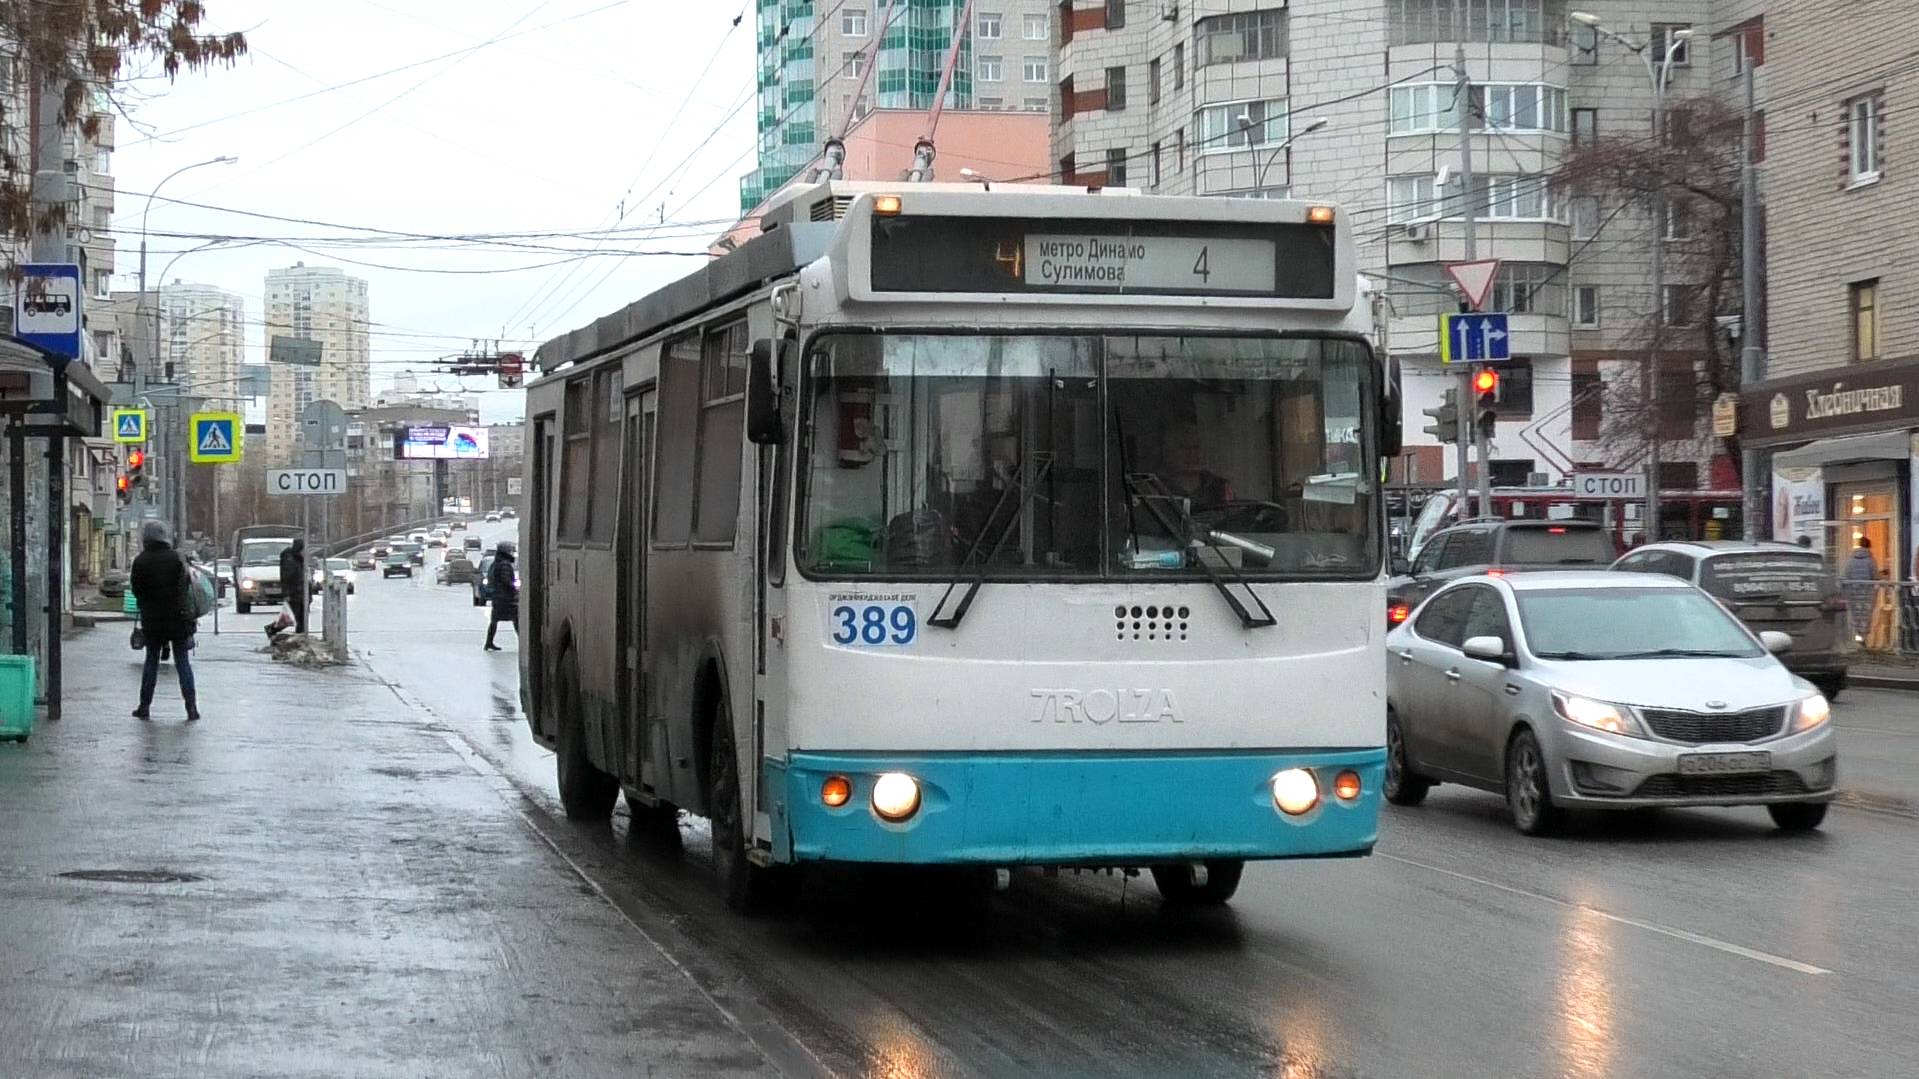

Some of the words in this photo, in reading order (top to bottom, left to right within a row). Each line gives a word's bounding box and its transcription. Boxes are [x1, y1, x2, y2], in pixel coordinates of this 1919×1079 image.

[1039, 241, 1084, 261] метро
[1087, 238, 1146, 261] Динамо
[1192, 246, 1211, 283] 4
[1041, 260, 1126, 283] Сулимова
[1805, 382, 1903, 419] Хлебничная
[278, 473, 336, 490] СТОП
[1584, 478, 1636, 494] СТОП
[832, 606, 916, 644] 389
[1030, 688, 1185, 725] TROLZA
